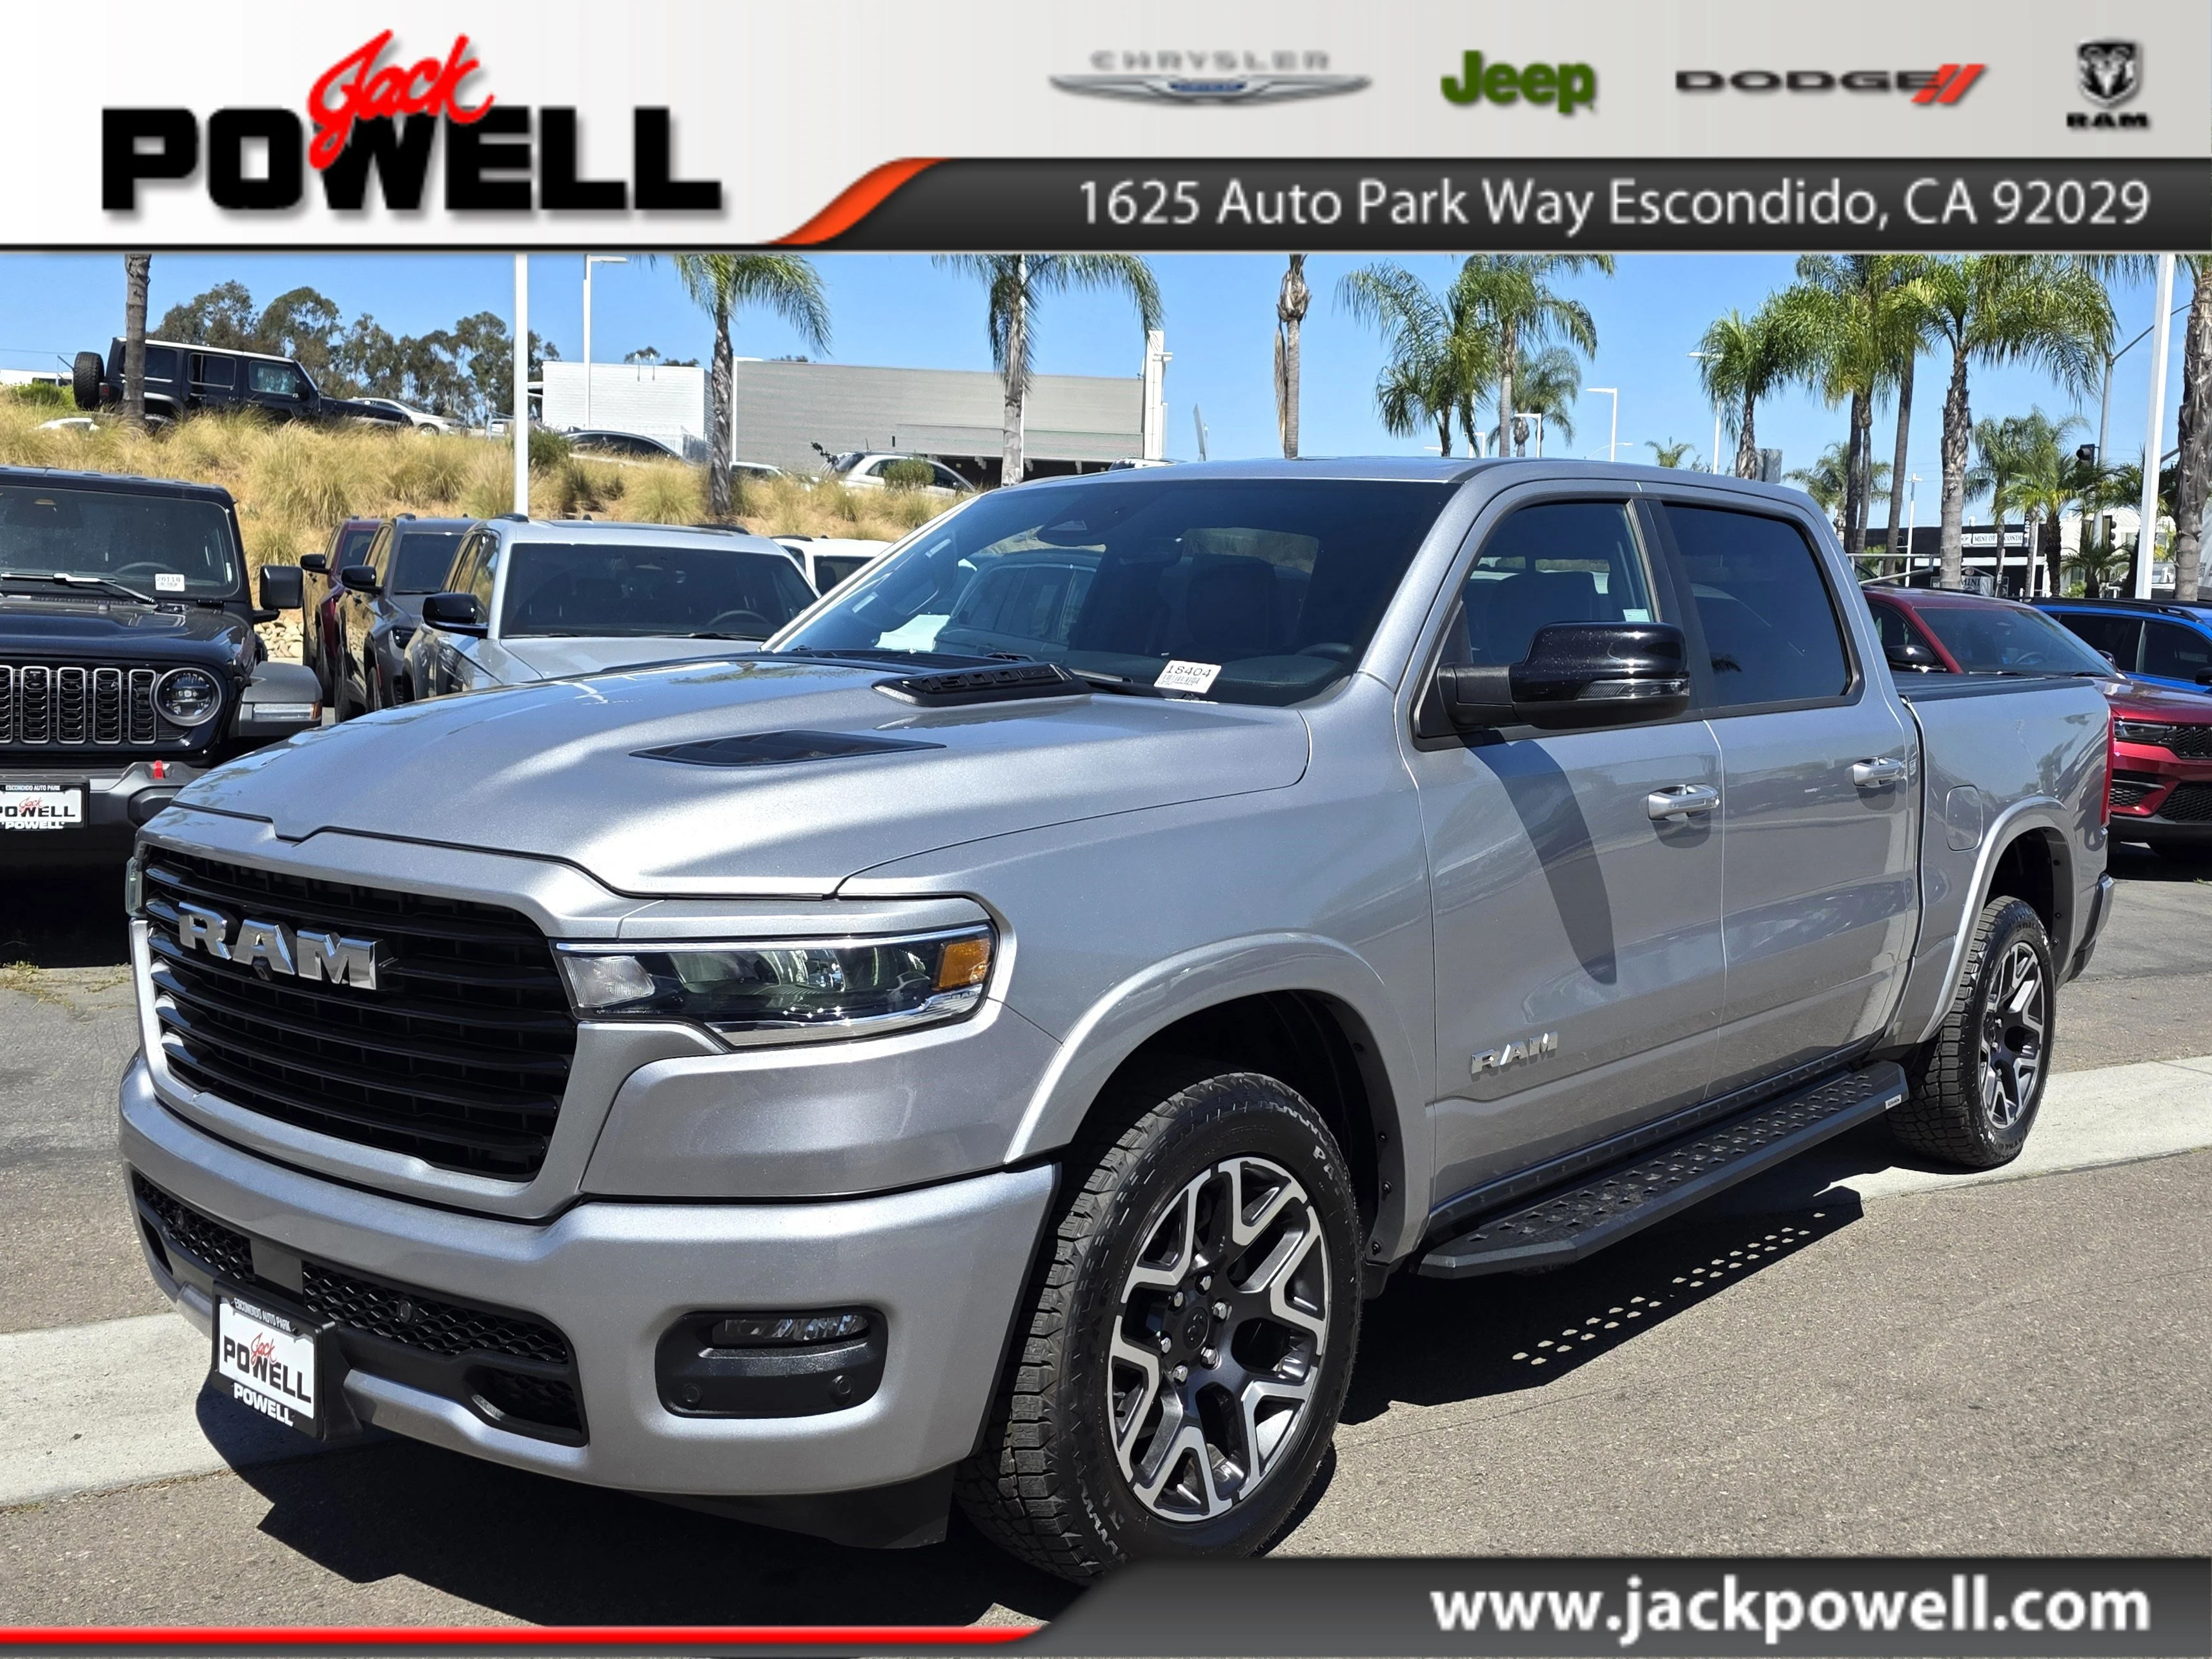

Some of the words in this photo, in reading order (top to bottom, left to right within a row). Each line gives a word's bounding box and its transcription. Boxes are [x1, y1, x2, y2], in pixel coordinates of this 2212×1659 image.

[1166, 665, 1212, 678] 18404
[0, 806, 76, 817] OWELL
[5, 821, 64, 830] POWELL
[178, 901, 377, 990] RAM
[1470, 1031, 1559, 1074] RAM
[262, 1309, 276, 1325] AUTO
[276, 1316, 291, 1332] PARK
[250, 1332, 278, 1366] Jack
[223, 1334, 312, 1404] POWELL
[233, 1382, 294, 1427] POWELL
